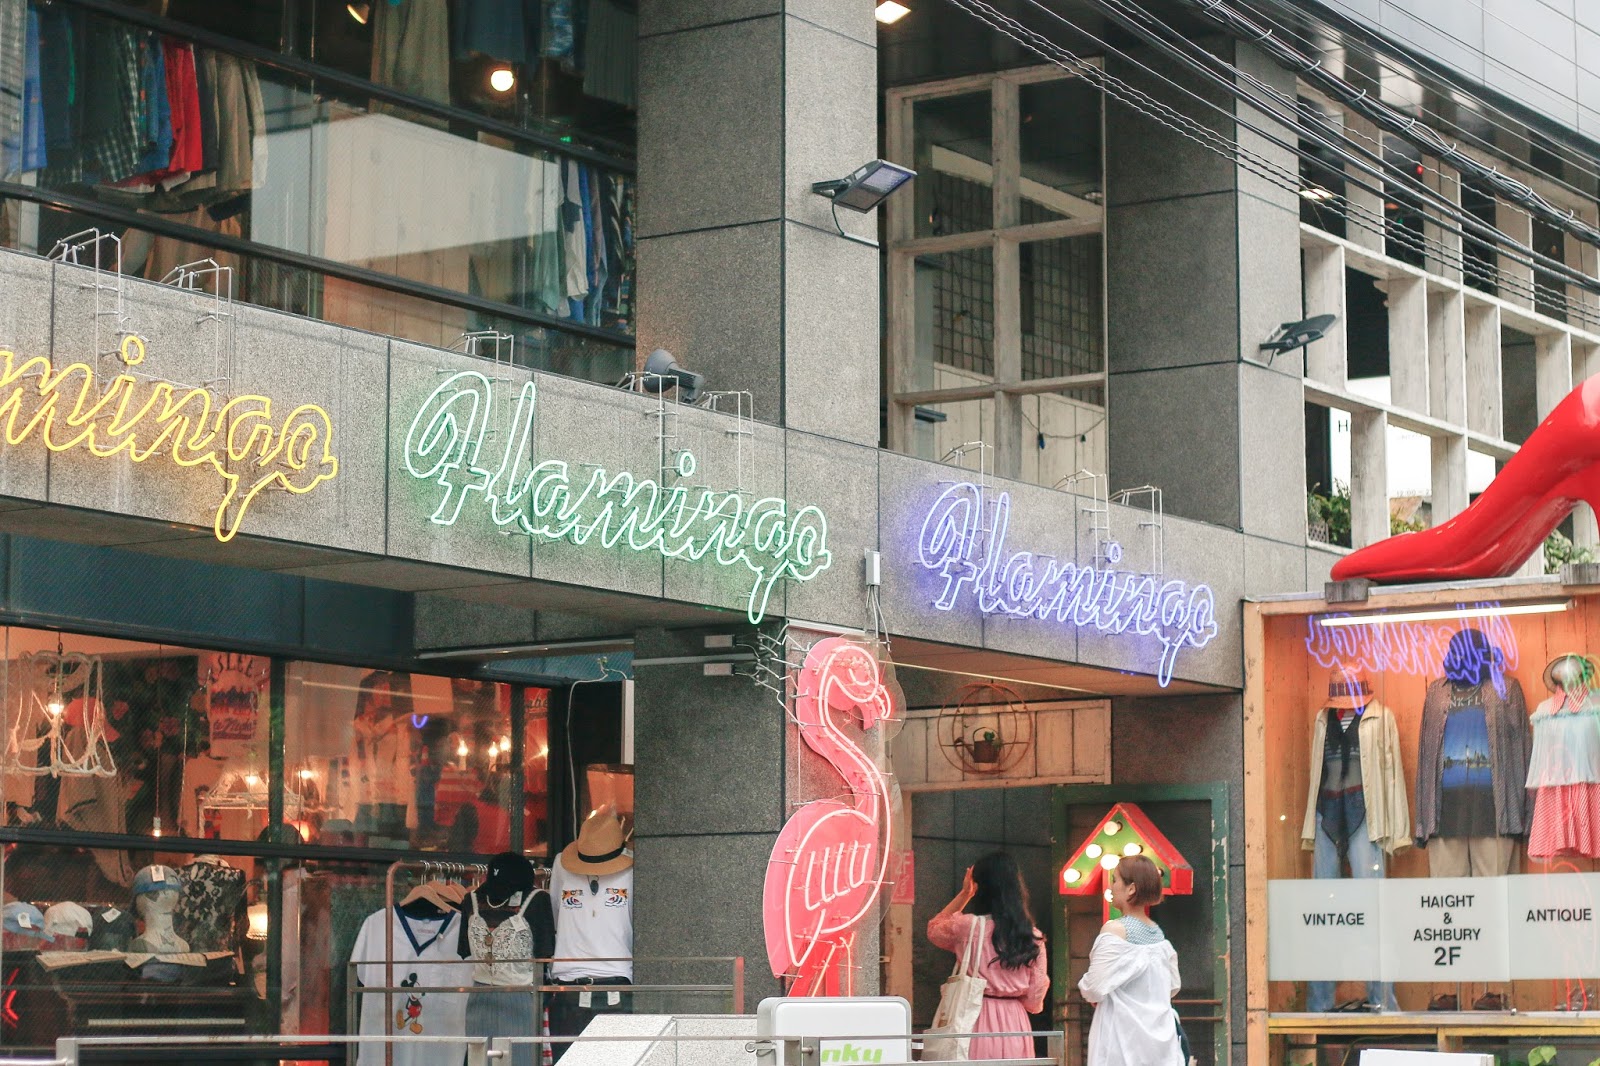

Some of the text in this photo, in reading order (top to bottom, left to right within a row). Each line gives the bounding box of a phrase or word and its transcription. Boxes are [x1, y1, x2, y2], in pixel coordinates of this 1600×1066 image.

[0, 334, 338, 542] mingo
[404, 370, 832, 625] Flamingo
[918, 481, 1219, 688] Flamingo
[1420, 894, 1475, 908] HAIGHT
[1302, 912, 1365, 926] VINTAGE
[1443, 912, 1452, 924] &
[1525, 908, 1592, 922] ANTIQUE
[1413, 928, 1481, 942] ASHBURY
[1434, 946, 1462, 966] 2F
